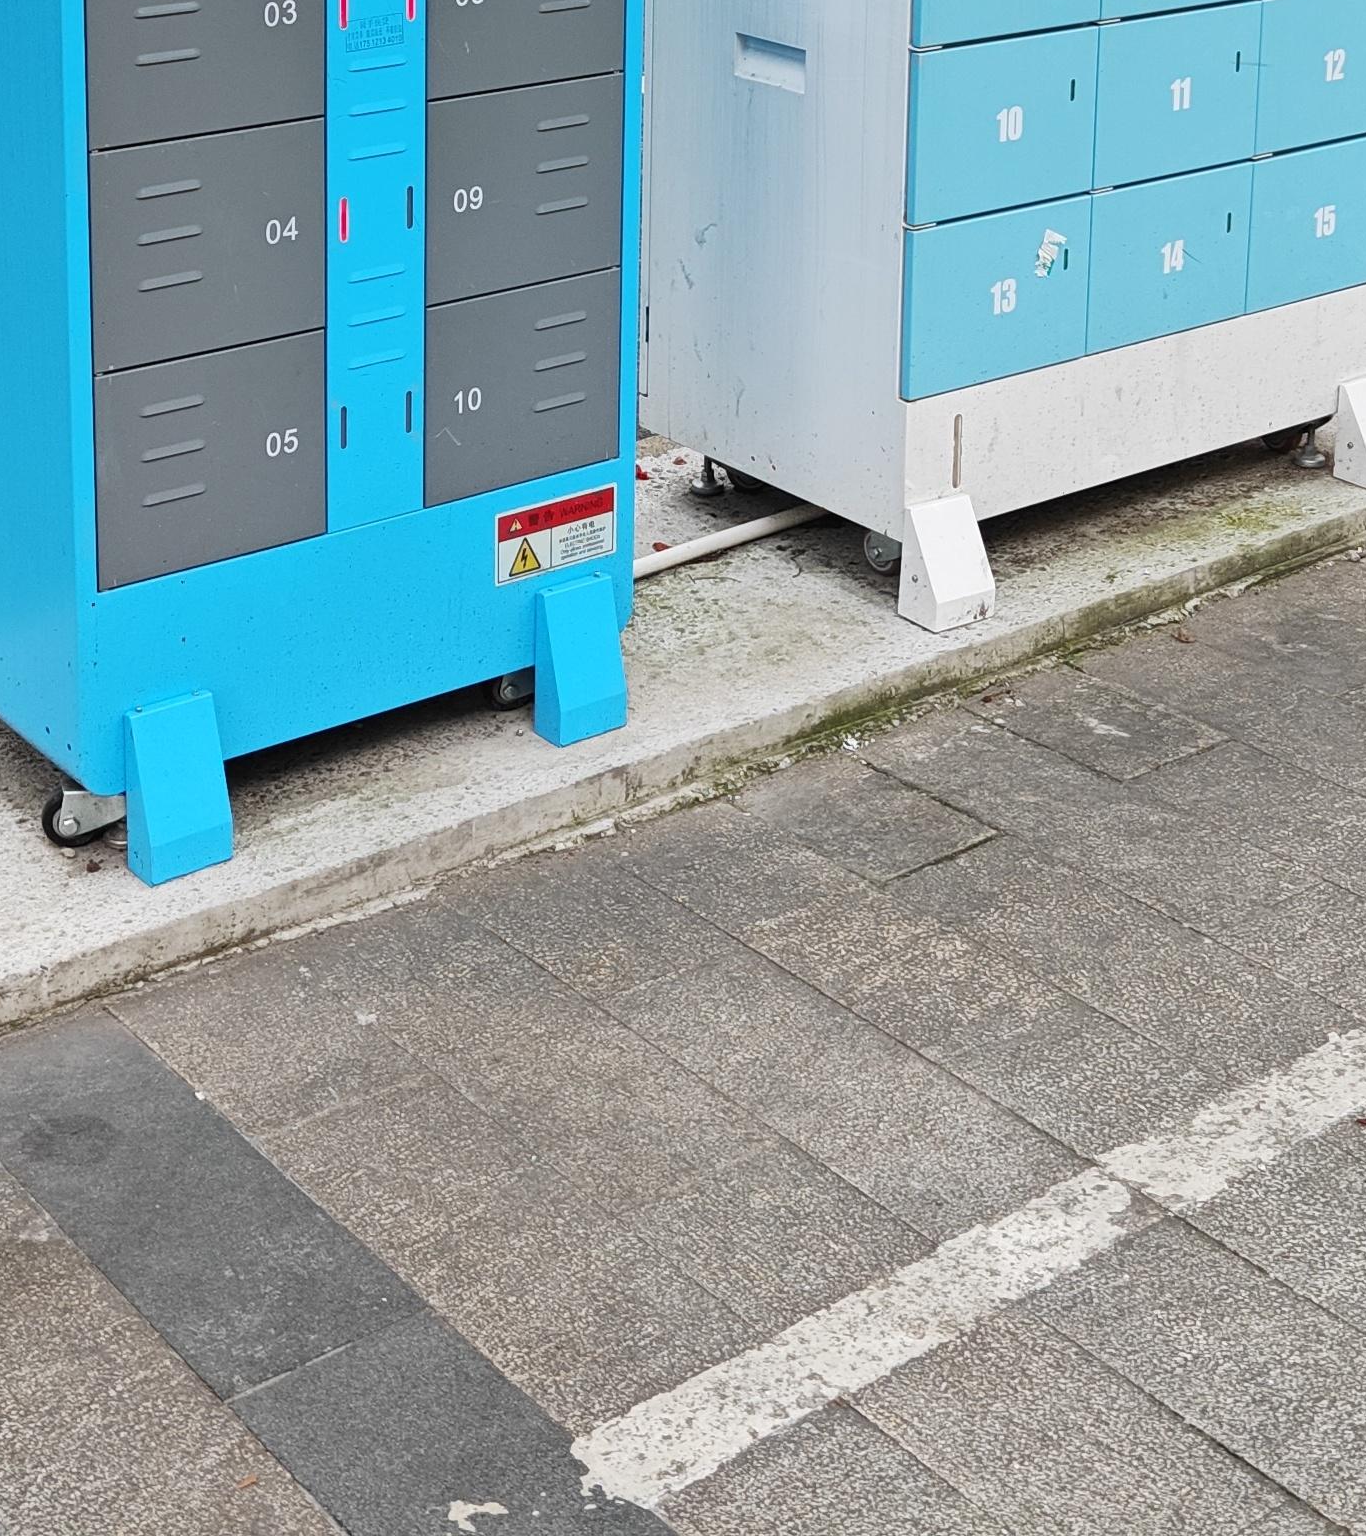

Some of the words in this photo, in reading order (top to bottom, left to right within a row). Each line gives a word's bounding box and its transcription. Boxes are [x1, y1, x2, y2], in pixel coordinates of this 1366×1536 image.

[264, 0, 298, 27] 03
[1324, 48, 1346, 82] 12
[1170, 77, 1191, 111] 11
[996, 105, 1023, 142] 10
[453, 185, 483, 213] 09
[265, 216, 299, 245] 04
[1314, 205, 1336, 238] 15
[1161, 239, 1184, 274] 14
[990, 278, 1017, 315] 13
[454, 387, 482, 414] 10
[266, 428, 299, 457] 05
[560, 497, 603, 518] WARNING
[567, 520, 595, 535] 小心有电
